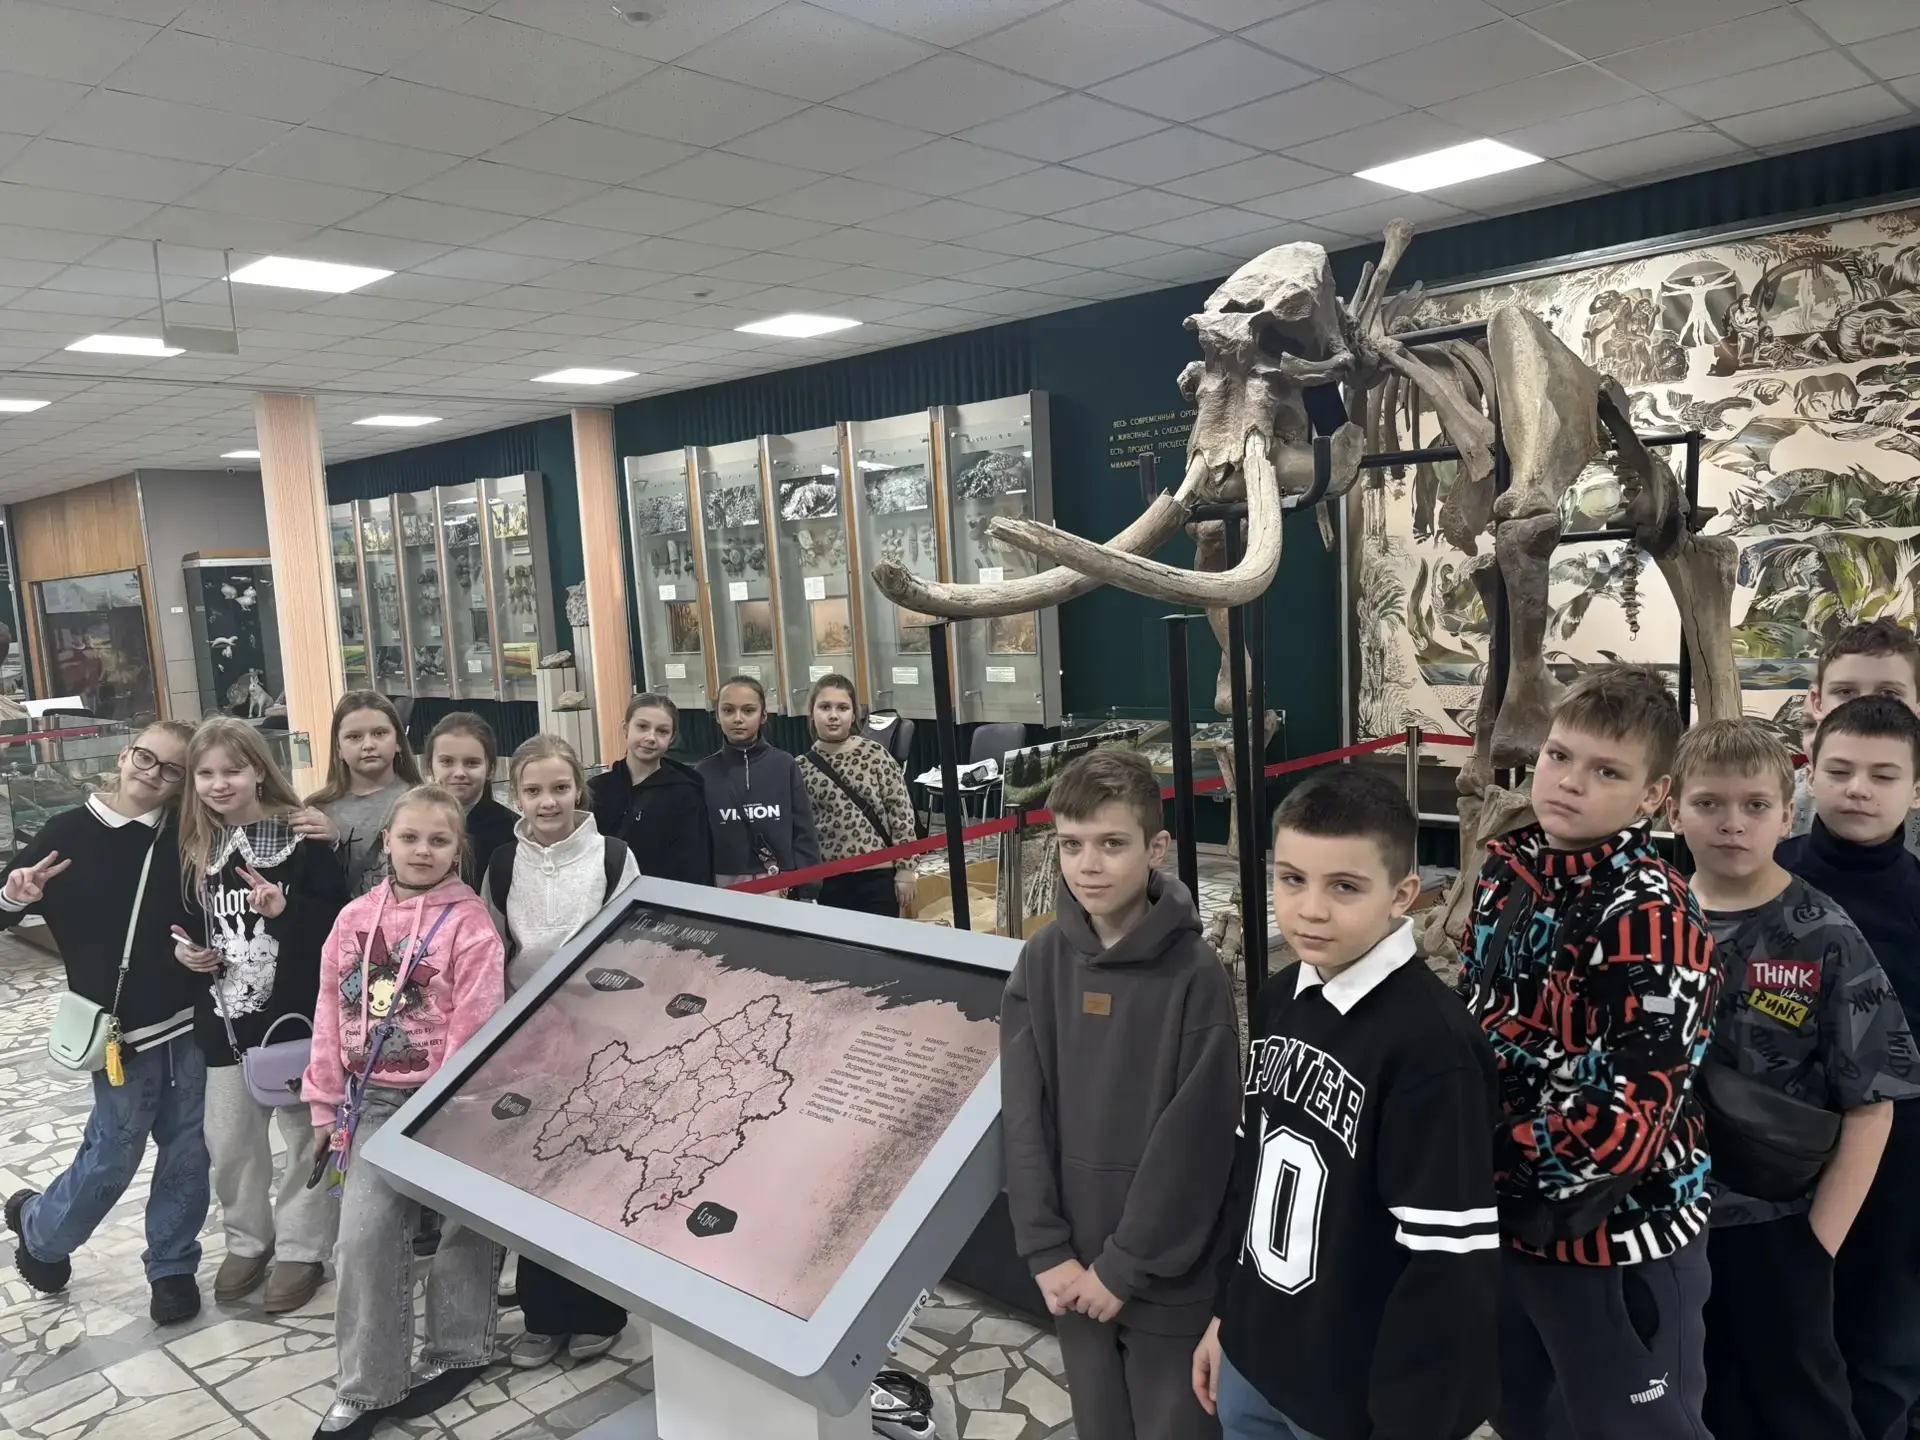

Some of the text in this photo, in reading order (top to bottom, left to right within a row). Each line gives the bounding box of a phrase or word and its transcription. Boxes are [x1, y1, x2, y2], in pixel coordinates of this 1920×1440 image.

[1113, 408, 1199, 428] ВЕСЬ СОВРЕМЕННЫЙ ОРГАН
[1161, 424, 1194, 435] СЛЕДОВАТ
[1110, 438, 1188, 456] ЕСТЬ ПРОДУКТ ПРОЦЕСС
[1110, 460, 1140, 469] МИЛЛИОН
[925, 1037, 948, 1046] мамонт
[963, 1046, 987, 1055] обитал
[904, 1050, 934, 1061] Брянской
[944, 1051, 981, 1064] территории
[844, 1062, 884, 1076] Встречаются
[891, 1075, 909, 1083] также
[875, 1062, 900, 1072] находят
[909, 1071, 930, 1079] многих
[846, 1083, 871, 1093] скелеты
[1630, 1384, 1665, 1404] PUMA
